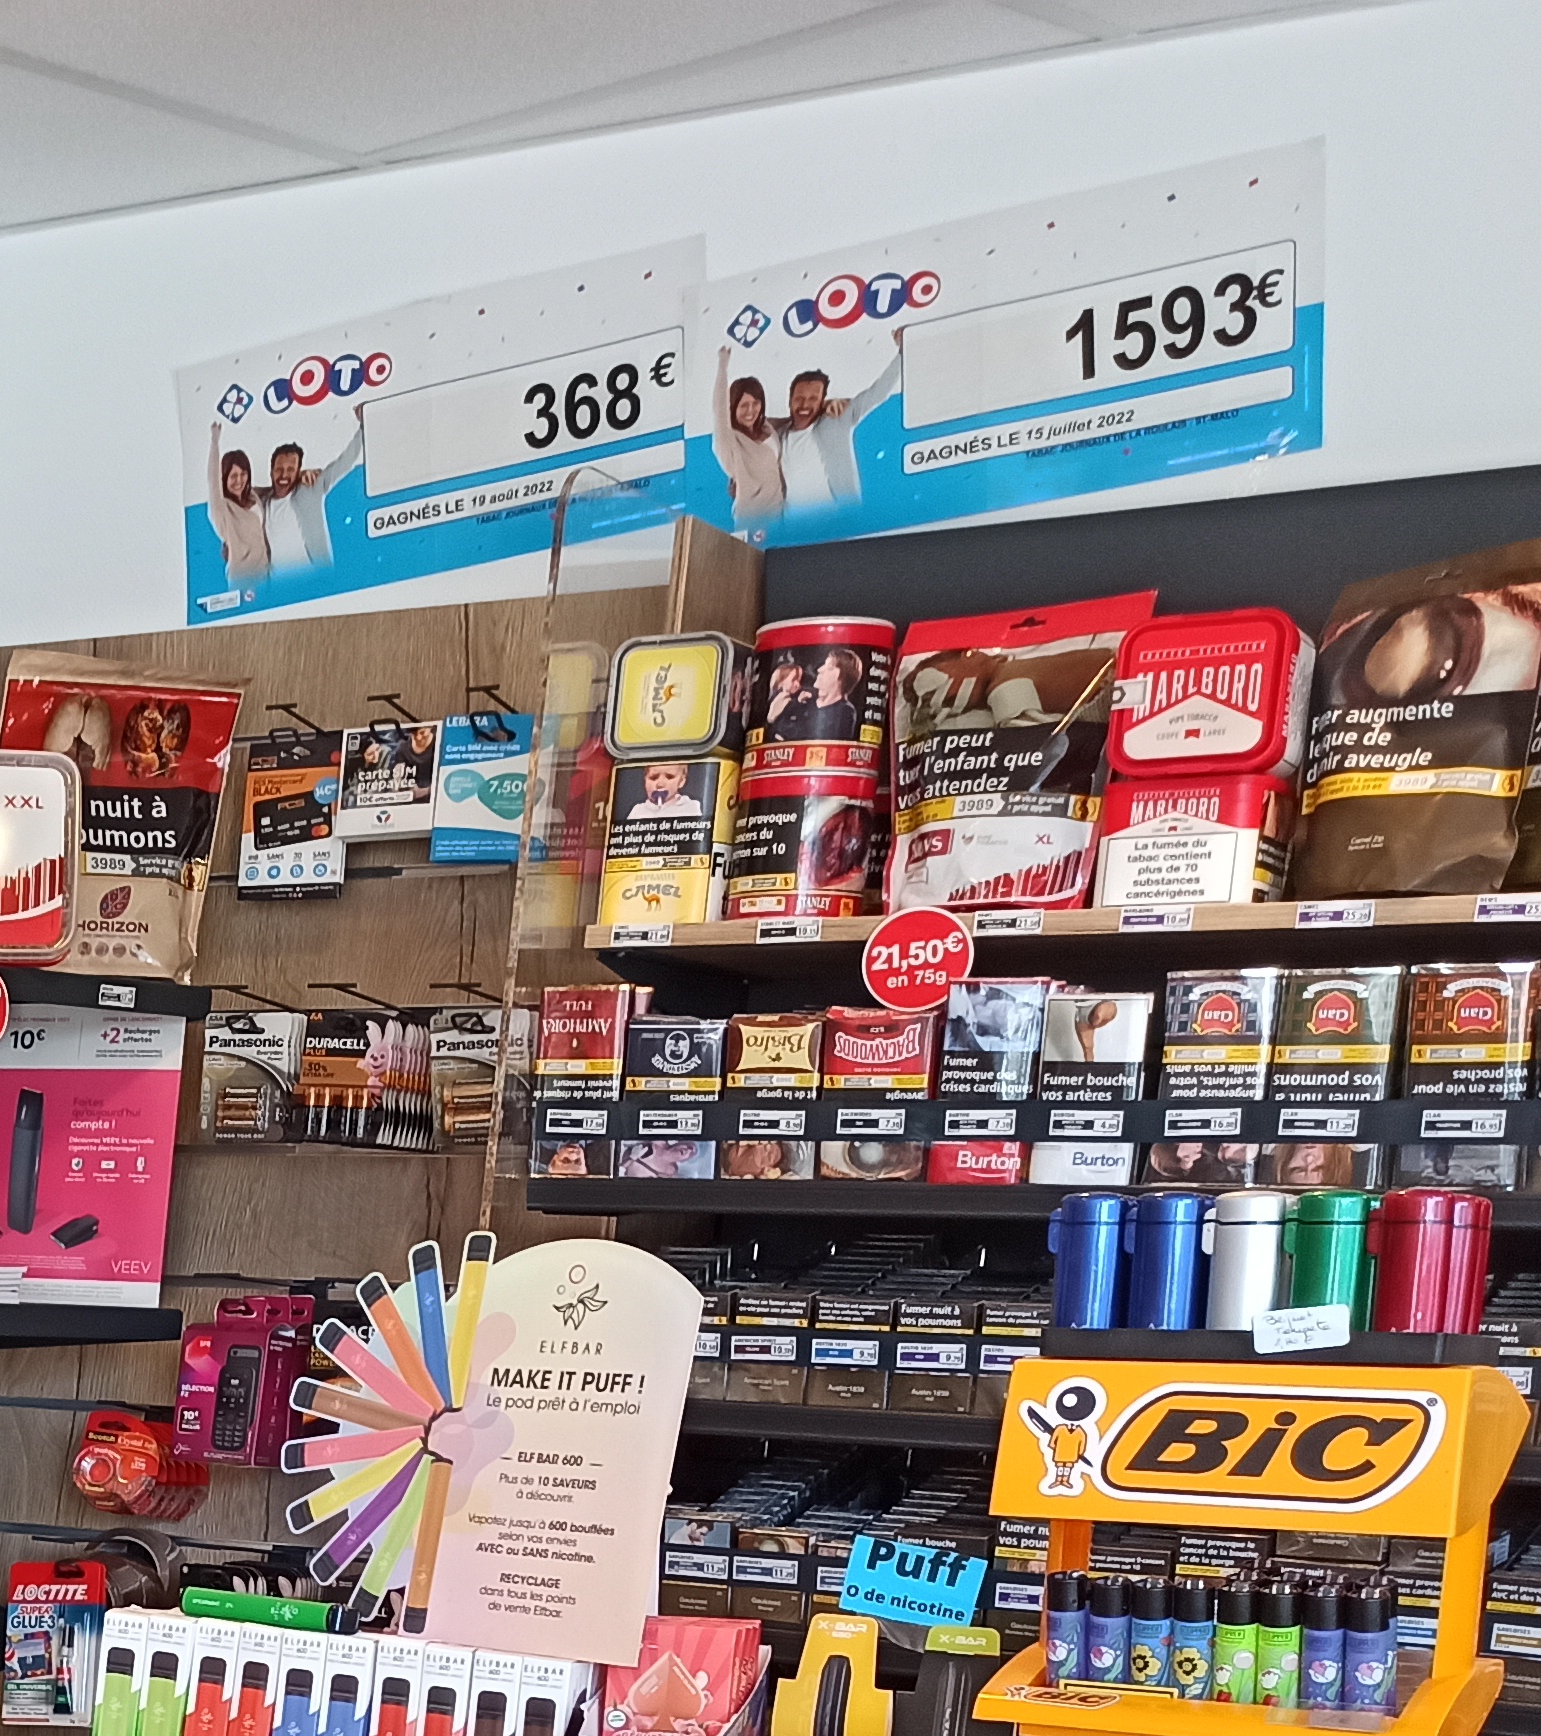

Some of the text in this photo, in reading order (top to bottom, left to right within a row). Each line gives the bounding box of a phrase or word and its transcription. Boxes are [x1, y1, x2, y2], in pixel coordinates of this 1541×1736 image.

[782, 270, 941, 337] LOTO
[263, 352, 392, 414] LOTO
[910, 409, 1135, 465] GAGNÉS LE 15 juillet 2022
[374, 480, 554, 531] GAGNÉS LE 19 août 2022
[1346, 701, 1454, 725] augmente
[945, 731, 993, 753] peut
[924, 751, 1043, 776] l'enfant que
[1343, 750, 1433, 772] aveugle
[924, 775, 1009, 797] attendez
[4, 794, 44, 810] XXL
[89, 795, 166, 819] nuit à
[1127, 850, 1211, 864] tabac contient
[1138, 863, 1198, 877] plus de 70
[1133, 875, 1200, 887] substances
[622, 883, 682, 899] CAMEL
[887, 969, 947, 989] en 75g
[208, 1035, 284, 1049] Panasonic
[306, 1037, 366, 1051] DURACELL
[1043, 1073, 1135, 1087] Fumer bouche
[957, 1151, 1020, 1171] Burton
[1073, 1152, 1125, 1168] Burton
[111, 1259, 152, 1275] VEEV
[540, 1340, 603, 1356] ELFBAR
[490, 1367, 633, 1394] MAKE IT PUFF
[487, 1394, 640, 1417] Le pod prêt à l'emploi
[518, 1452, 583, 1467] ELF BAR 600
[537, 1475, 597, 1491] 10 SAVEURS
[548, 1518, 615, 1537] 600 bouffées
[476, 1542, 504, 1555] AVEC
[505, 1546, 519, 1557] ou
[521, 1545, 549, 1559] SANS
[866, 1538, 969, 1588] Puff
[500, 1572, 561, 1590] RECYCLAGE
[13, 1584, 87, 1600] LOCTITE
[864, 1587, 886, 1605] de
[889, 1593, 965, 1623] nicotine
